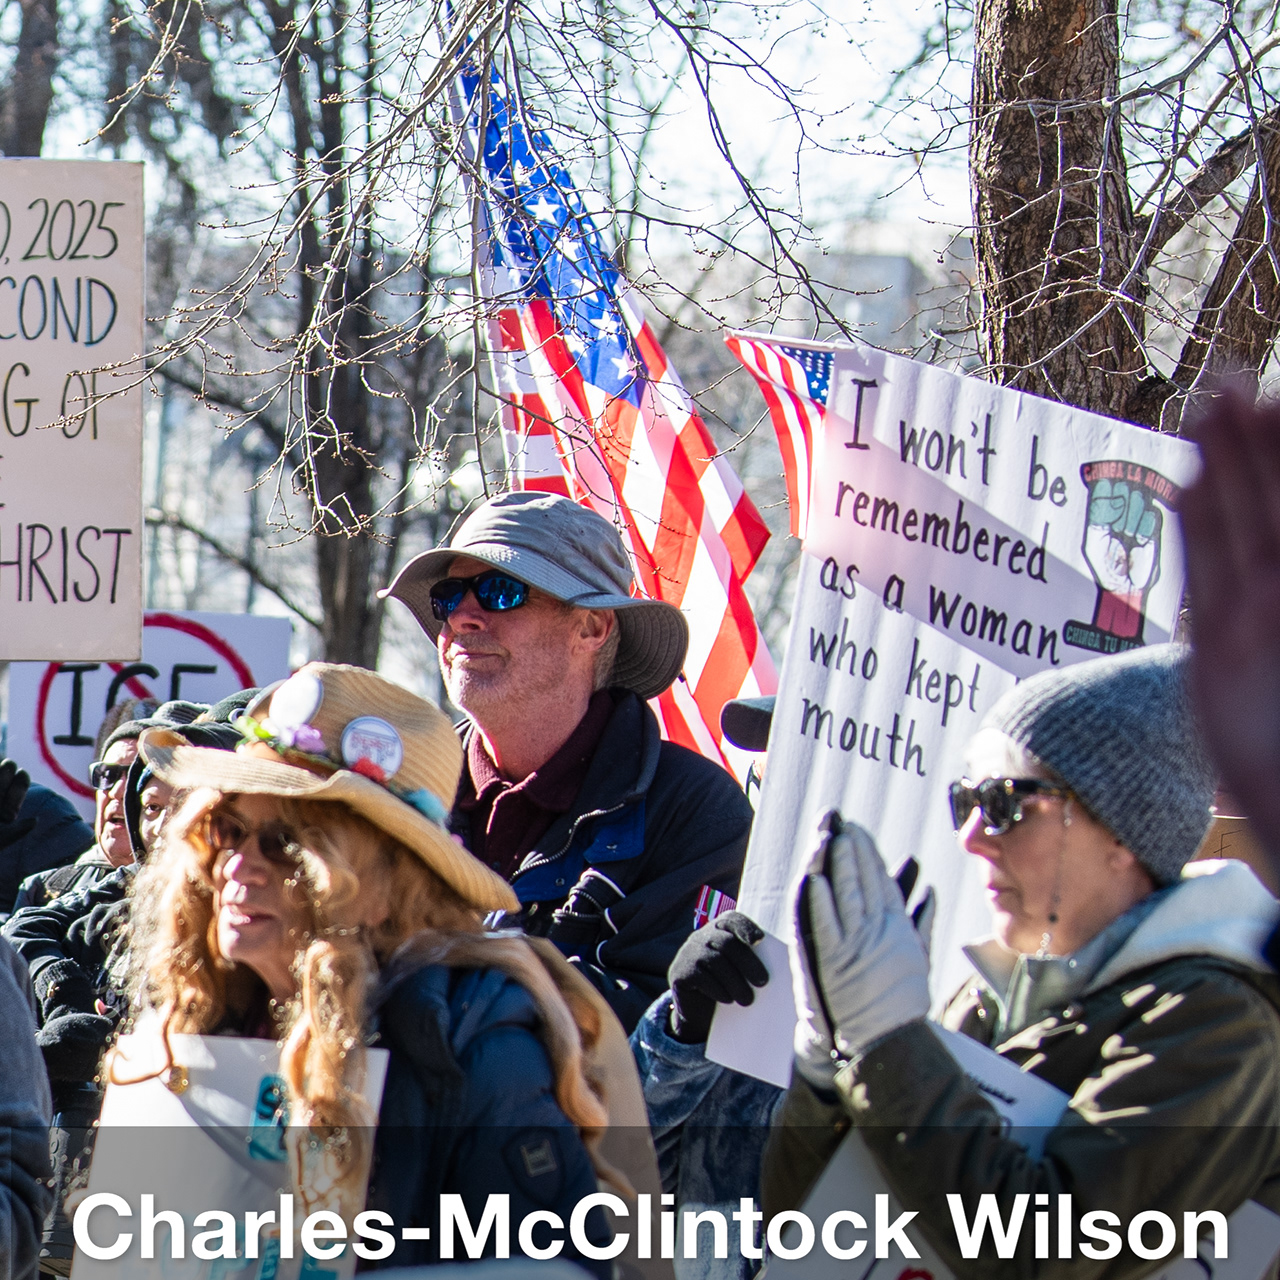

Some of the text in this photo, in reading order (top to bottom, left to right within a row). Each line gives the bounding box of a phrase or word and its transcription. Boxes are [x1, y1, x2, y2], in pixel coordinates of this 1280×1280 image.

[20, 197, 126, 262] 2025
[844, 377, 1068, 508] I won't be
[834, 481, 1048, 584] remembered
[819, 556, 1060, 665] as a woman
[810, 617, 980, 727] who kept
[800, 697, 926, 777] mouth
